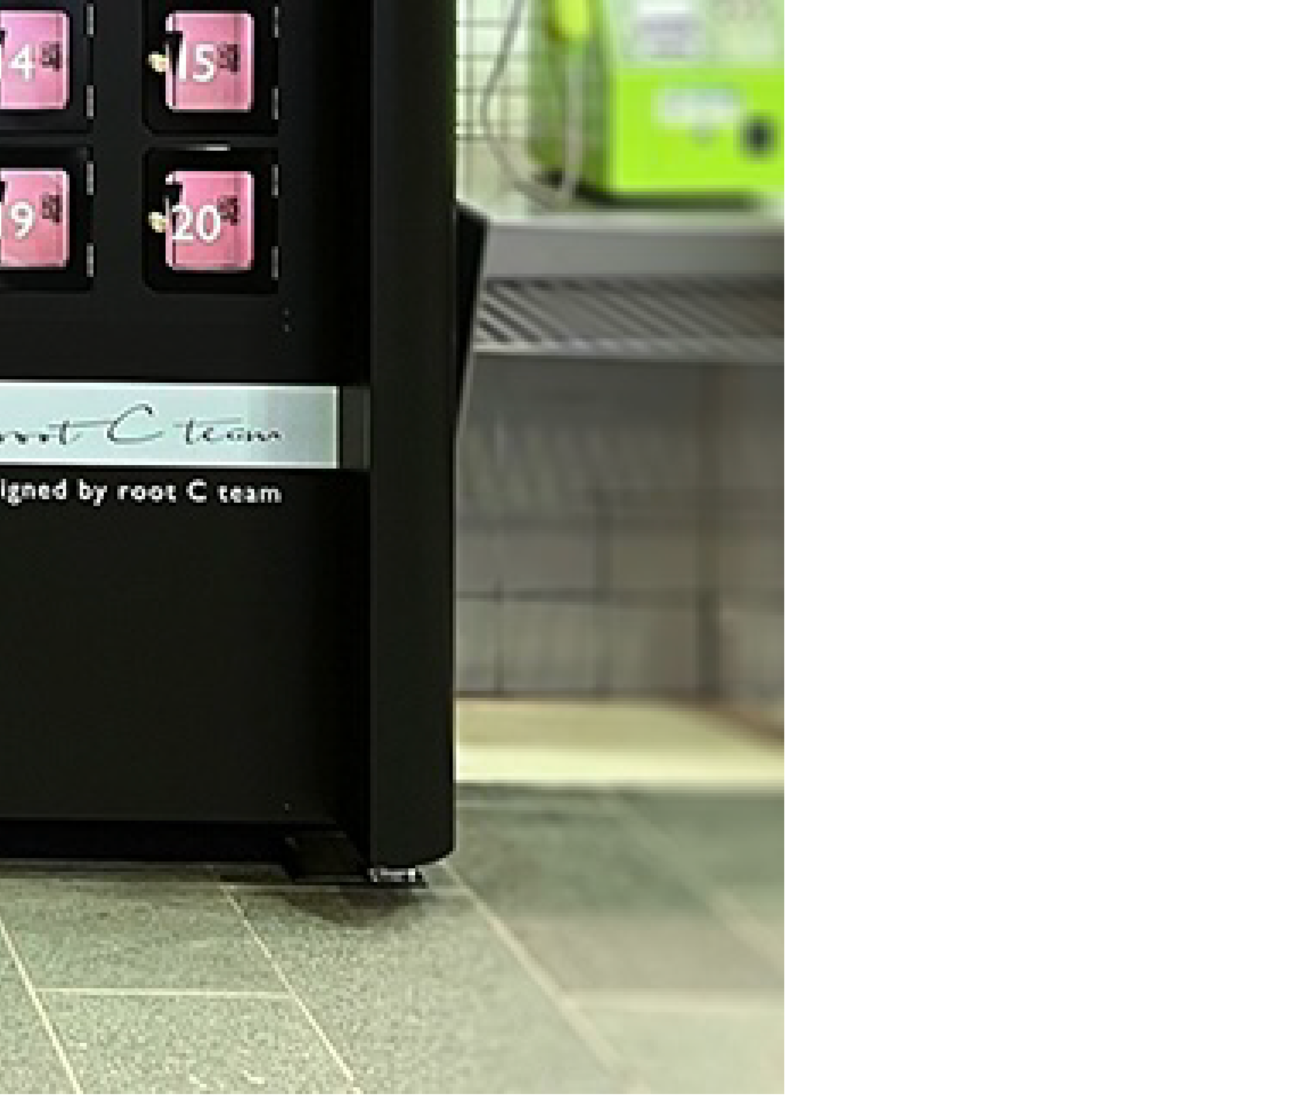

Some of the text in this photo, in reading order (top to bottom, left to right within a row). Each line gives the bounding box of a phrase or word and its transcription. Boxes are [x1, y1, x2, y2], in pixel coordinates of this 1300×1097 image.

[179, 43, 217, 82] 15
[172, 204, 221, 243] 20
[106, 403, 165, 443] C
[173, 417, 284, 445] team
[79, 478, 108, 507] by
[116, 481, 177, 503] root
[186, 479, 208, 503] C
[217, 483, 283, 504] team
